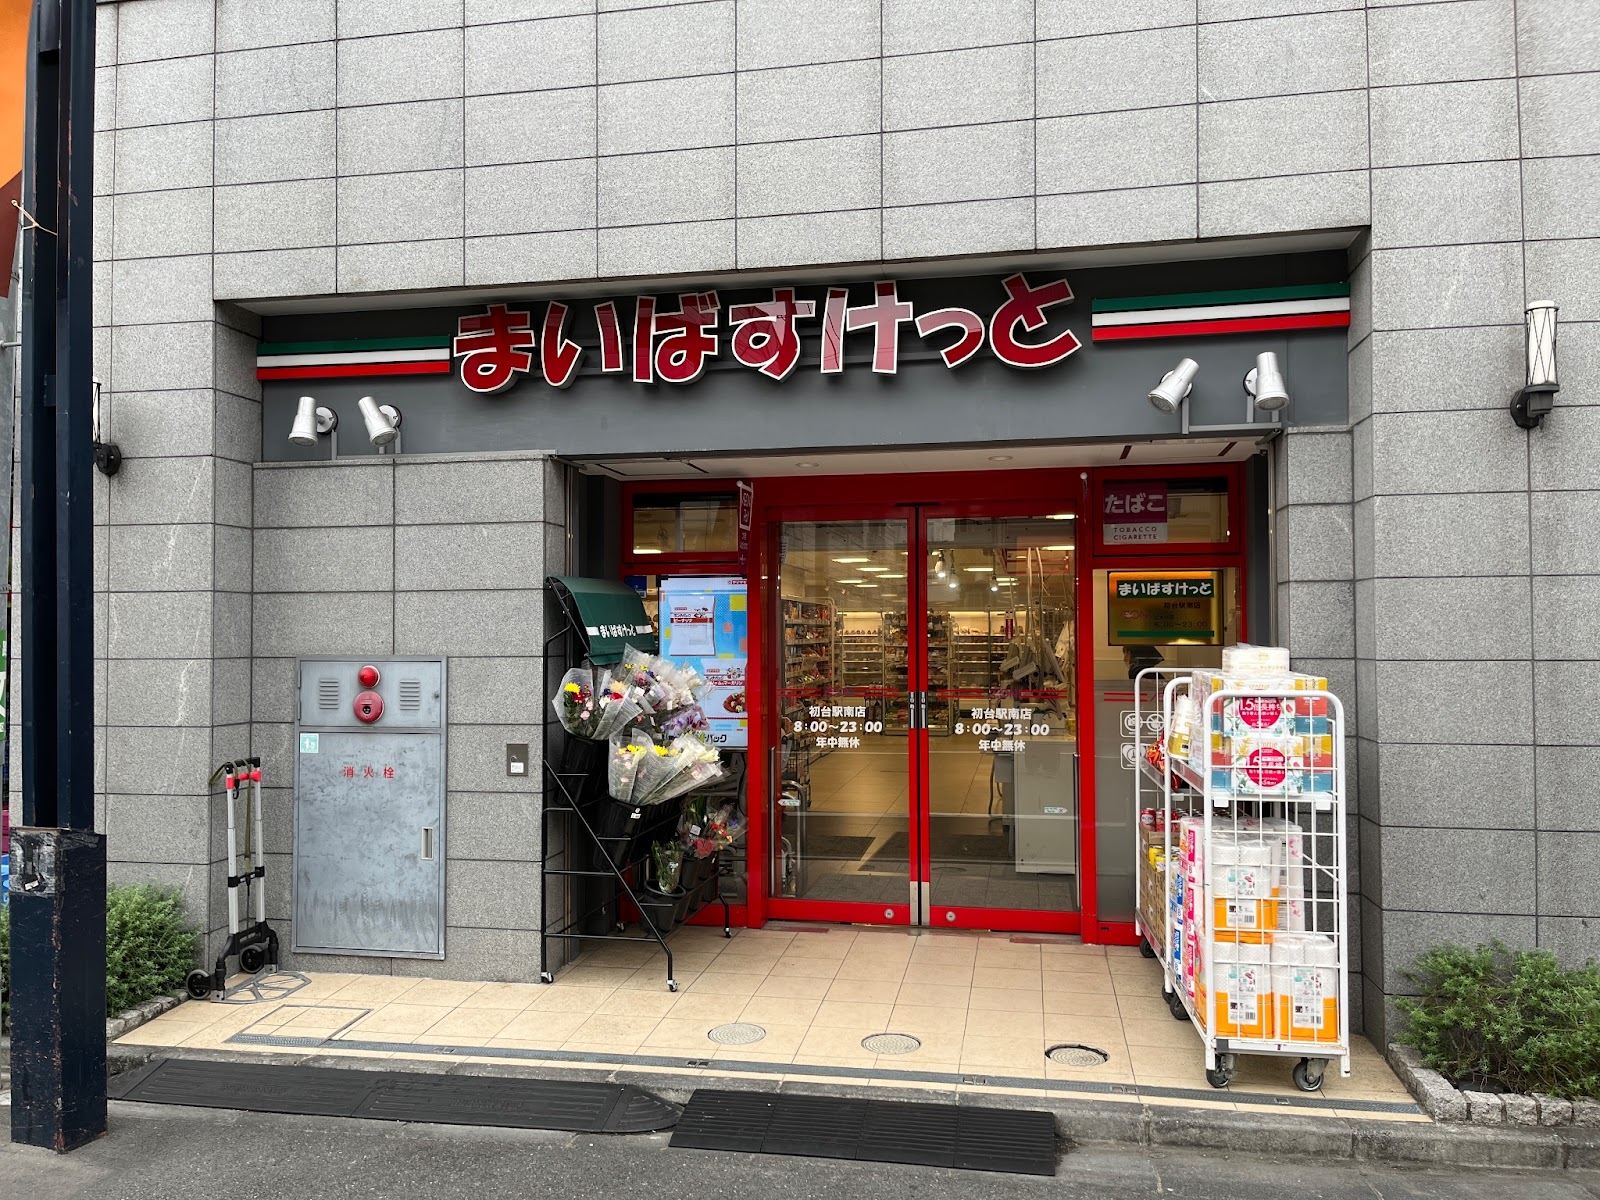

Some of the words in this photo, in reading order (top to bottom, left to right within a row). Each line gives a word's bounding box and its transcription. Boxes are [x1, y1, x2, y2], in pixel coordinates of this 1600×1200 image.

[453, 271, 1083, 394] まいばすけっと
[1105, 493, 1165, 513] たばこ
[1113, 533, 1158, 541] CIGARETTE
[1118, 582, 1212, 596] まいばすけっと
[600, 624, 636, 638] まいばすけっと
[808, 706, 867, 718] 初台駅南店
[971, 708, 1032, 720] 初台駅南店
[816, 737, 861, 748] 年中無休
[978, 739, 1026, 752] 年中無休
[343, 766, 395, 779] 消火栓
